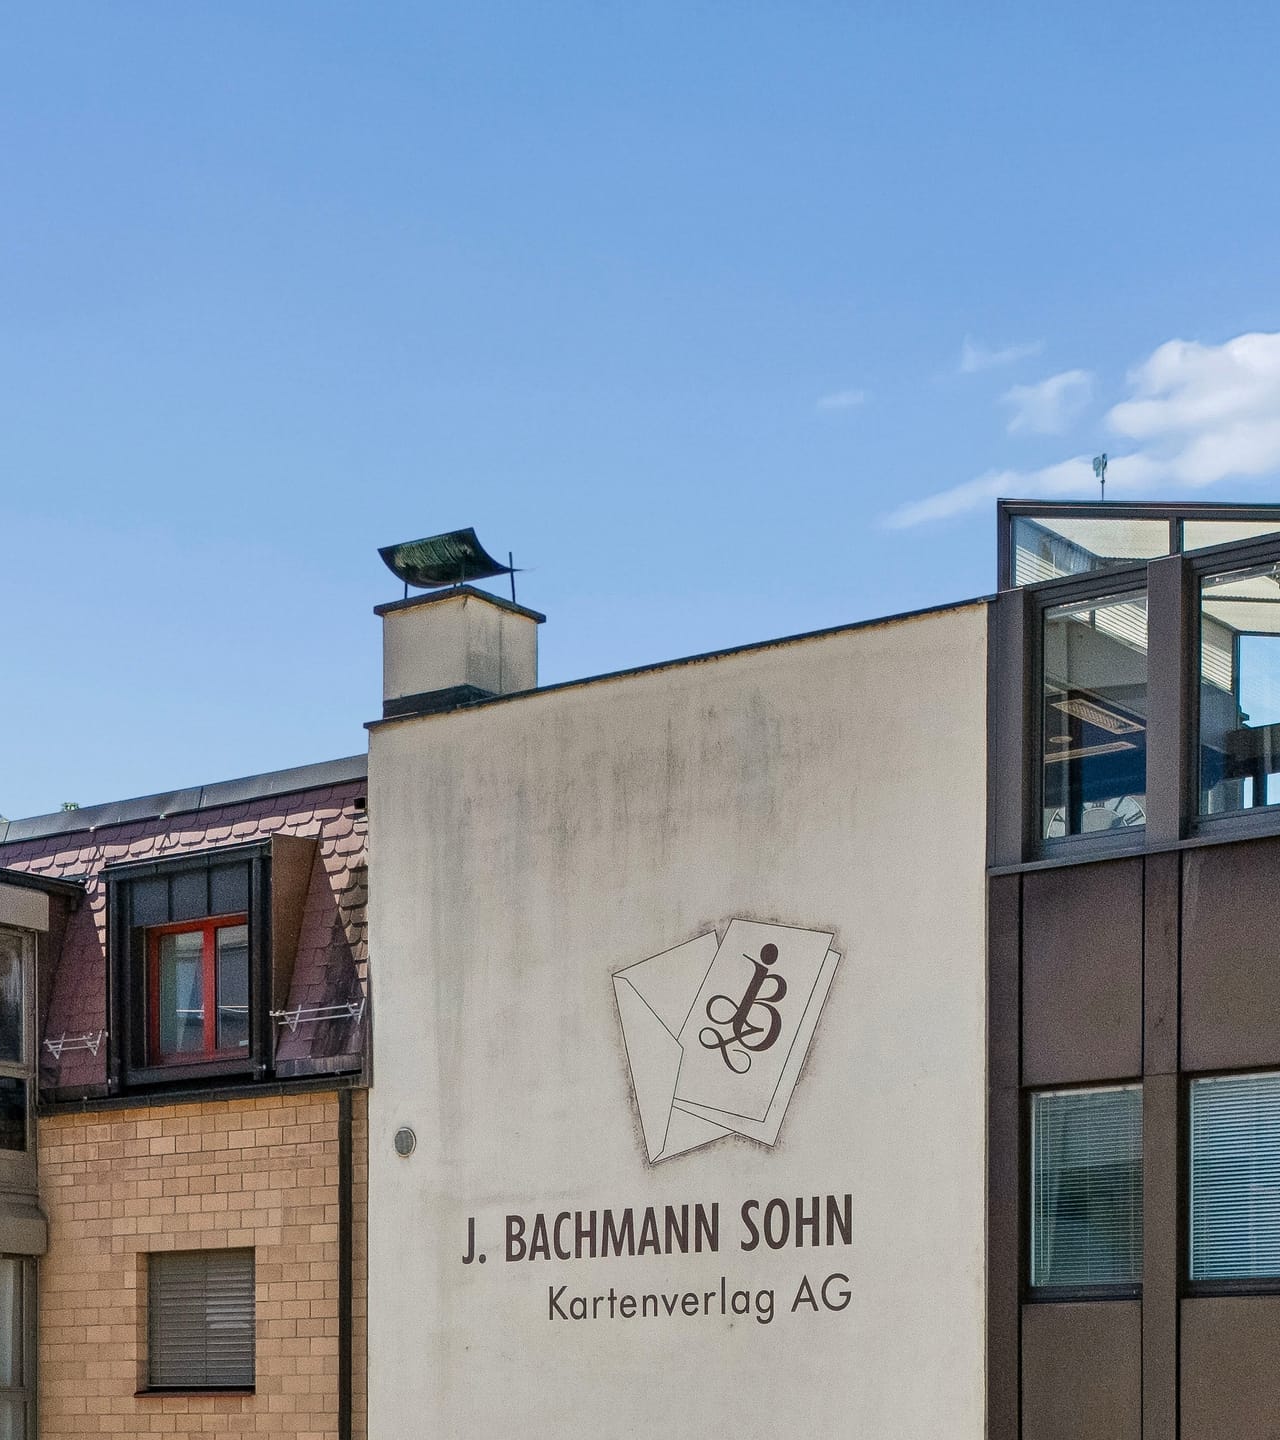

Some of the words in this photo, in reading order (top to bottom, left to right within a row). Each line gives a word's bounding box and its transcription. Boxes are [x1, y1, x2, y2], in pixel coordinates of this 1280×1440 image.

[461, 1217, 487, 1265] J.
[505, 1202, 719, 1262] BACHMANN
[740, 1193, 853, 1252] SOHN
[548, 1276, 775, 1325] Kartenverlag
[791, 1272, 852, 1313] AG
